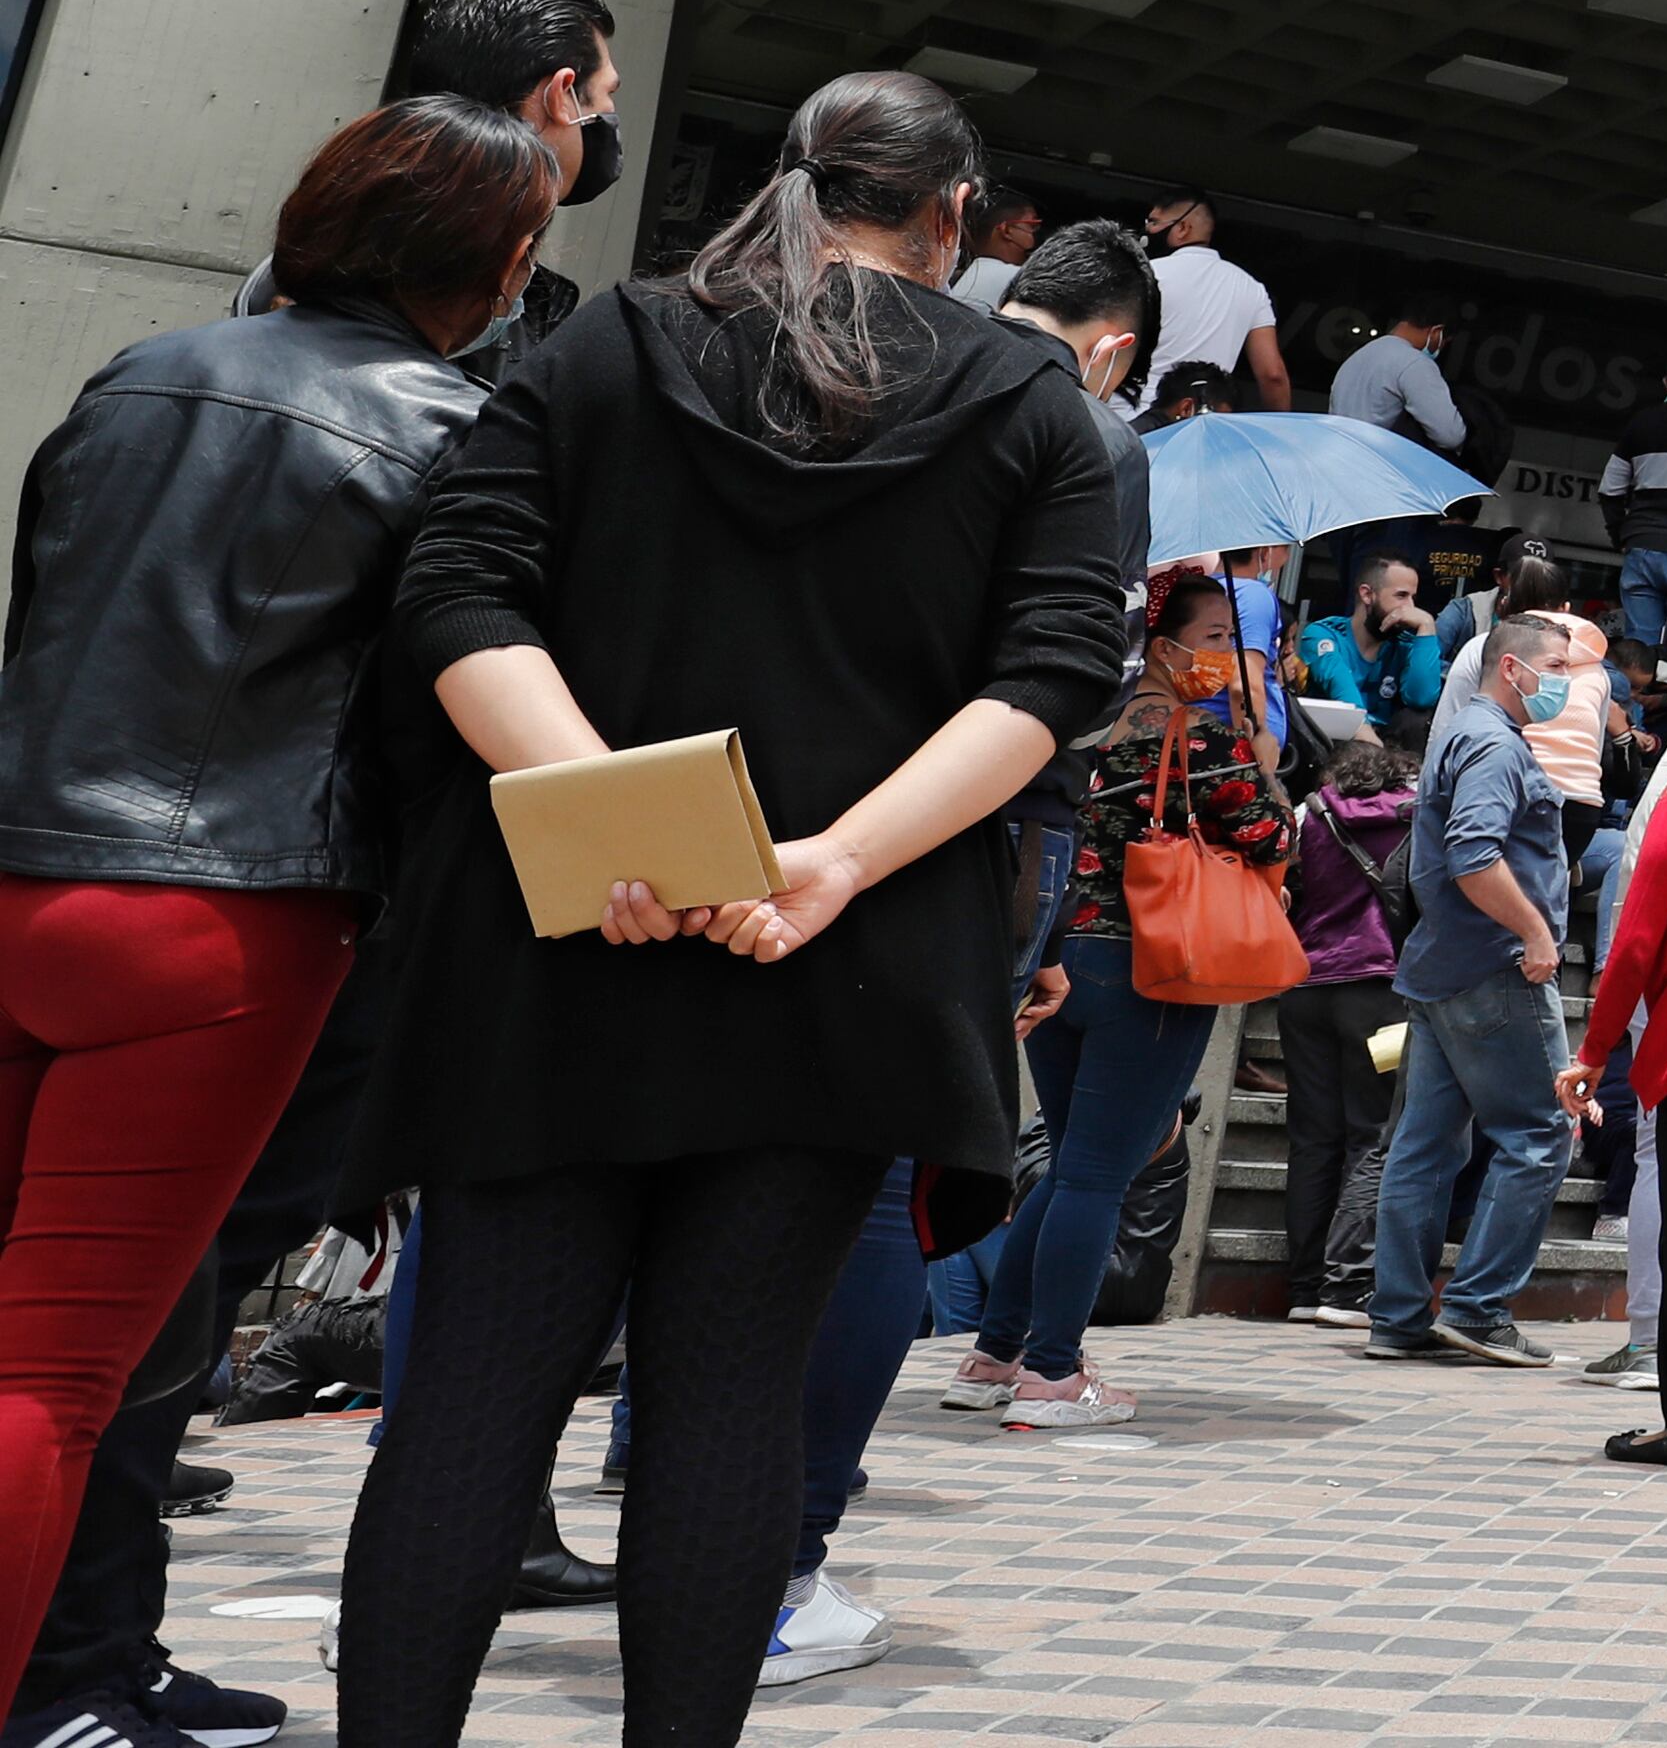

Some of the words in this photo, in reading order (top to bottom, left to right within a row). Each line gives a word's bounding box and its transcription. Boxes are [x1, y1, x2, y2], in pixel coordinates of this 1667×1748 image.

[1514, 466, 1603, 504] DIST
[1428, 552, 1482, 567] SEGURIDAD
[1433, 564, 1474, 578] PRIVADA
